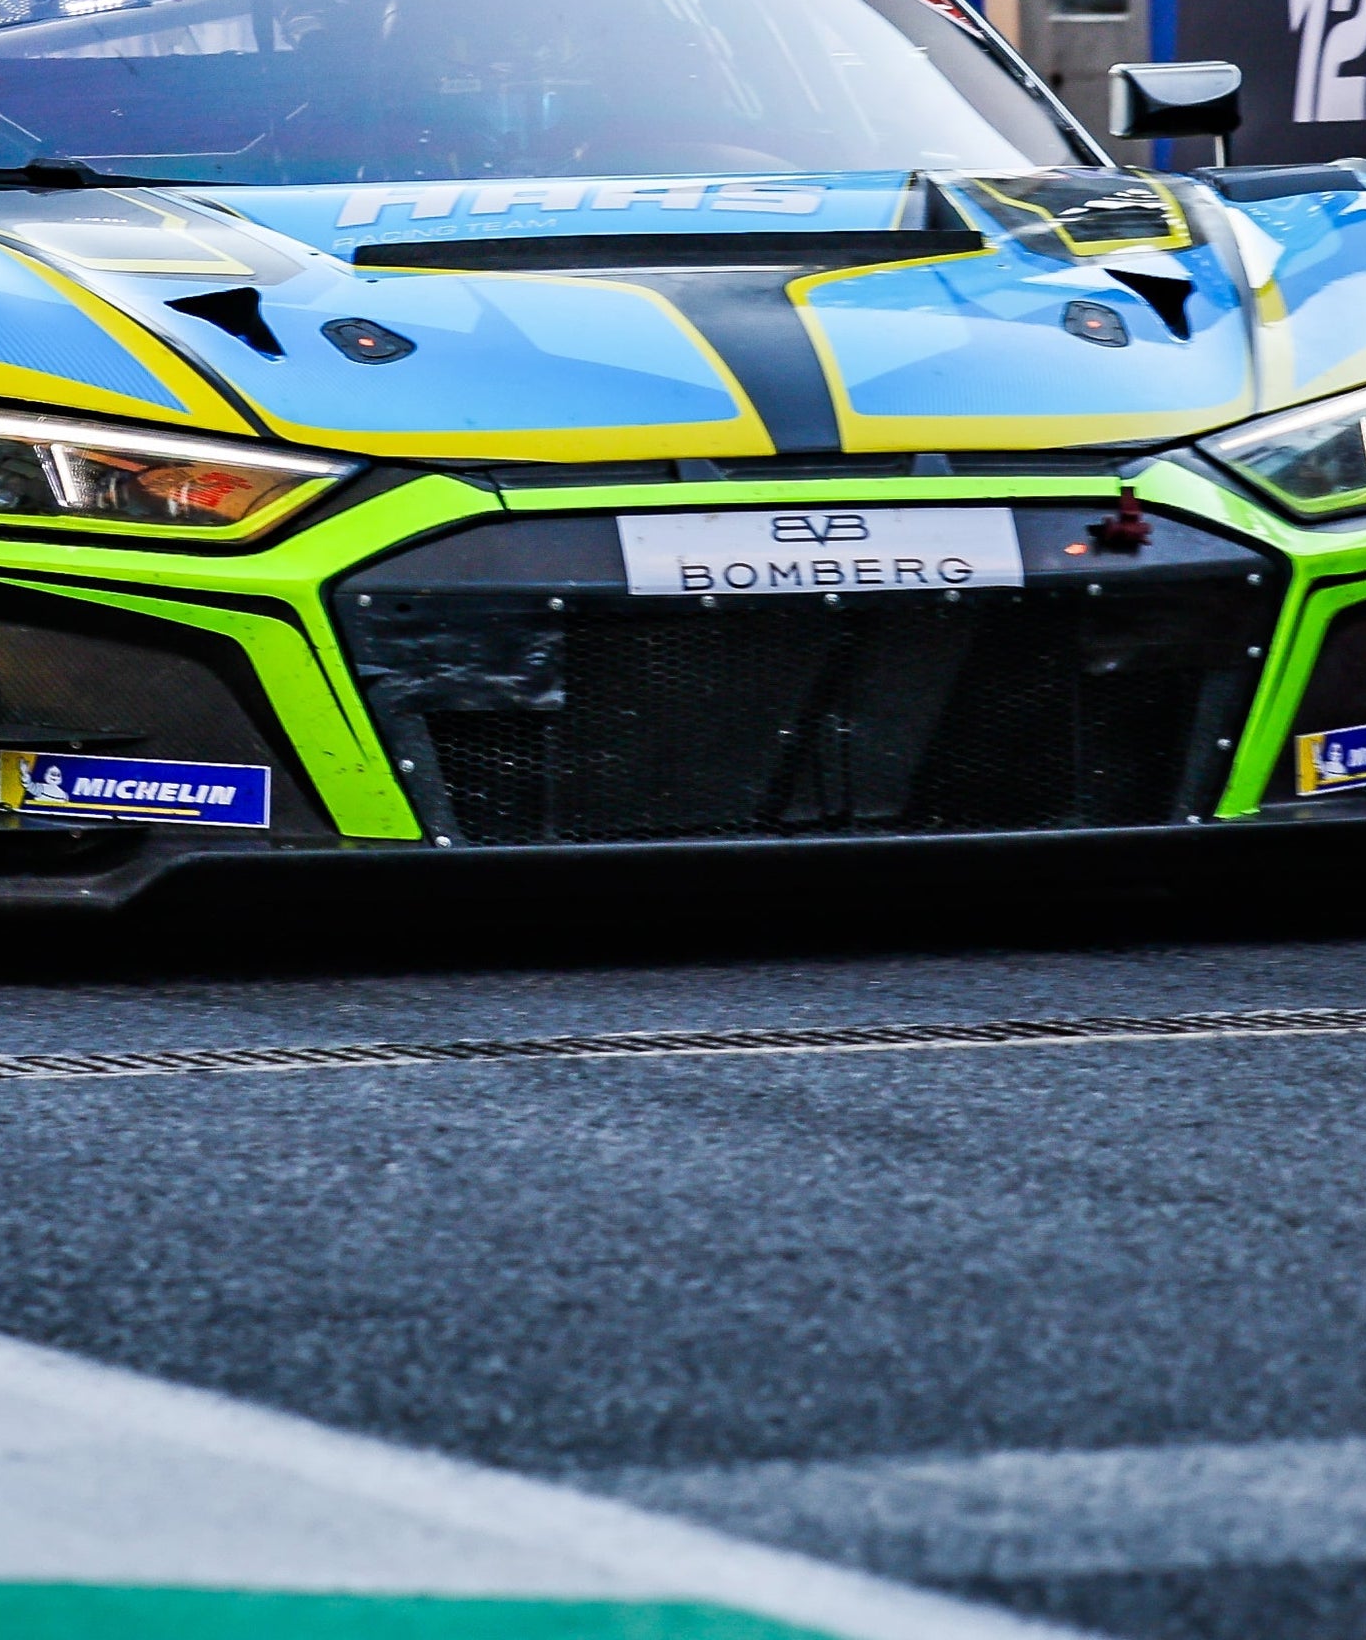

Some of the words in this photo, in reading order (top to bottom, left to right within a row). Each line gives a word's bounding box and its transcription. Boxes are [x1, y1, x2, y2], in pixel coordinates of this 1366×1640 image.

[335, 183, 828, 229] HAAS
[333, 225, 457, 251] RACING
[465, 218, 559, 233] TEAM
[680, 556, 975, 593] BOMBERG
[71, 776, 238, 806] MICHELIN
